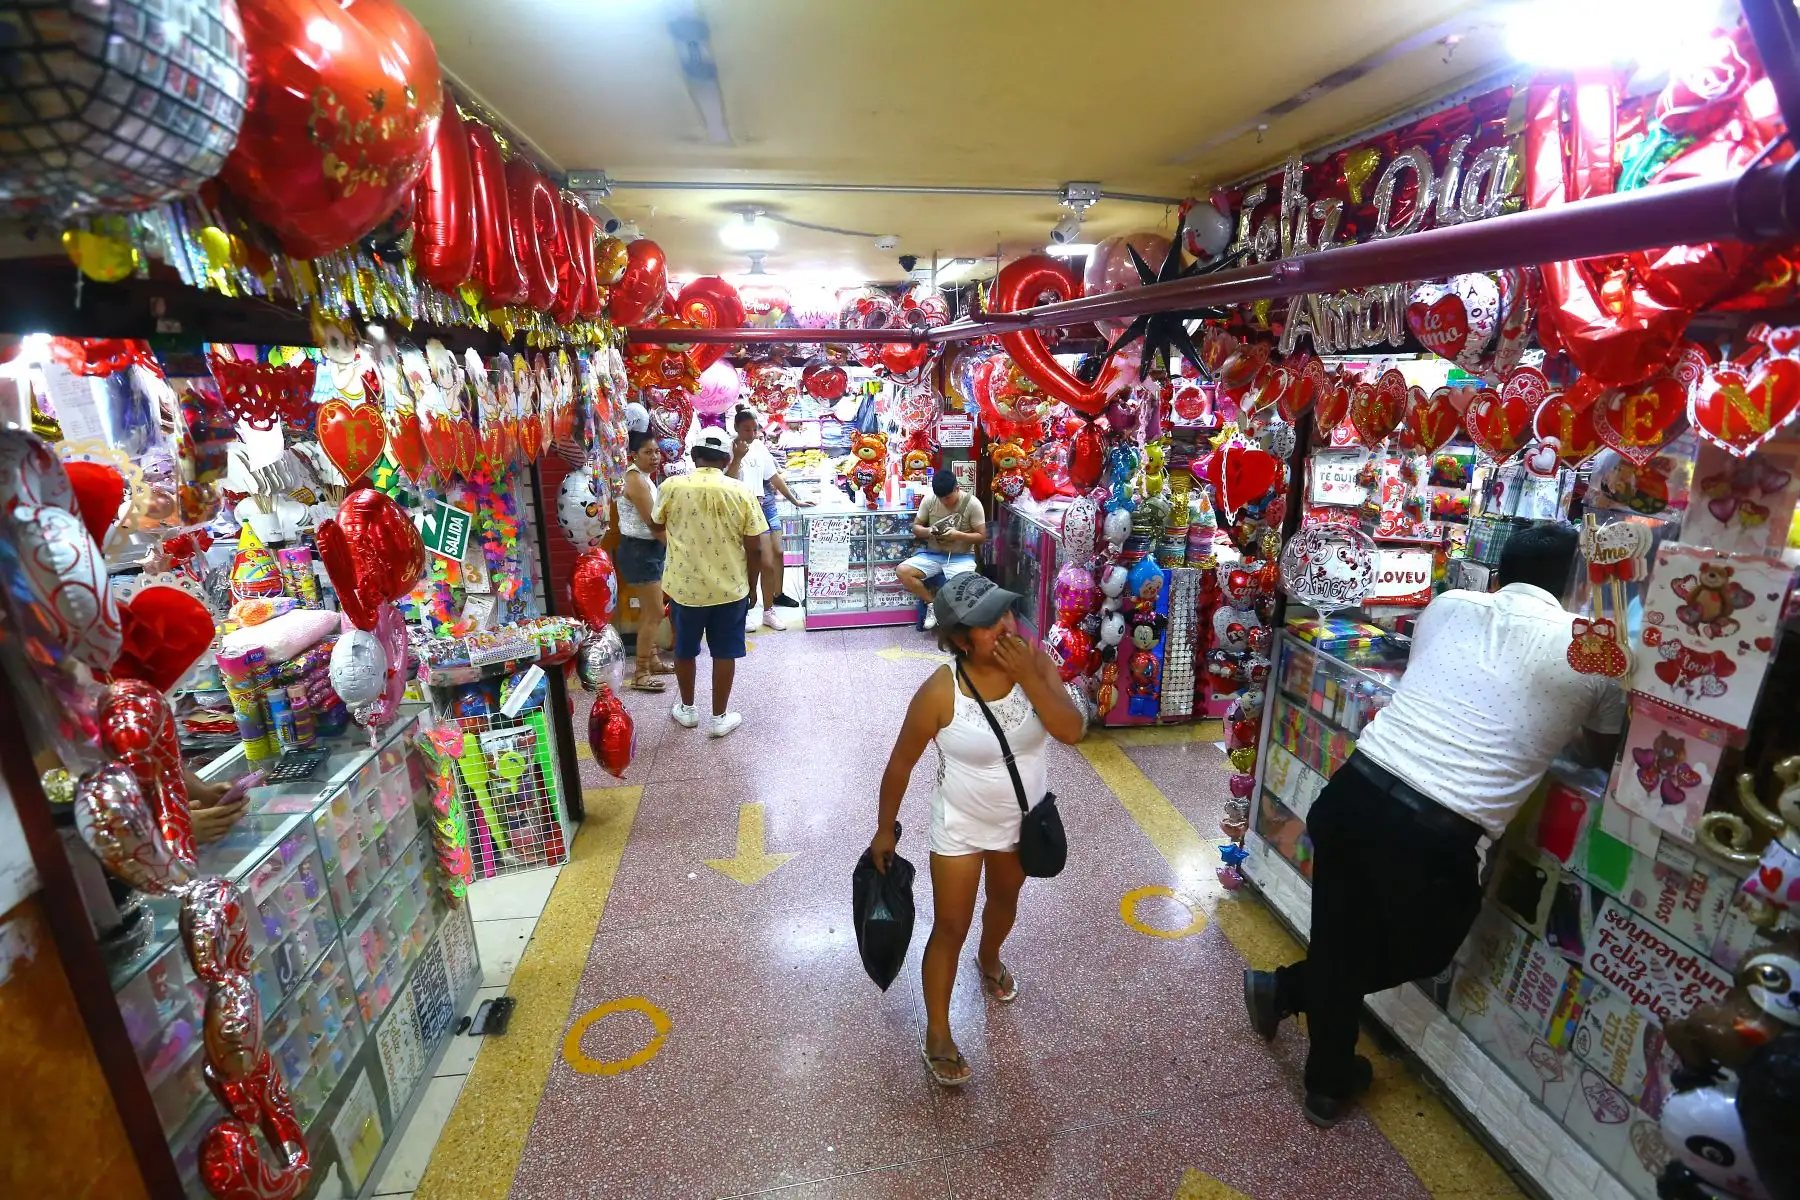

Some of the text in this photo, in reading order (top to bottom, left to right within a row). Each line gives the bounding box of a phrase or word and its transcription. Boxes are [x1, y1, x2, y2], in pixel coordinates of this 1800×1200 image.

[1424, 310, 1443, 330] te
[444, 515, 465, 557] SALIDA
[1598, 927, 1649, 980] Feliz
[1515, 951, 1547, 1013] SHOWER
[1532, 973, 1558, 1020] BABY
